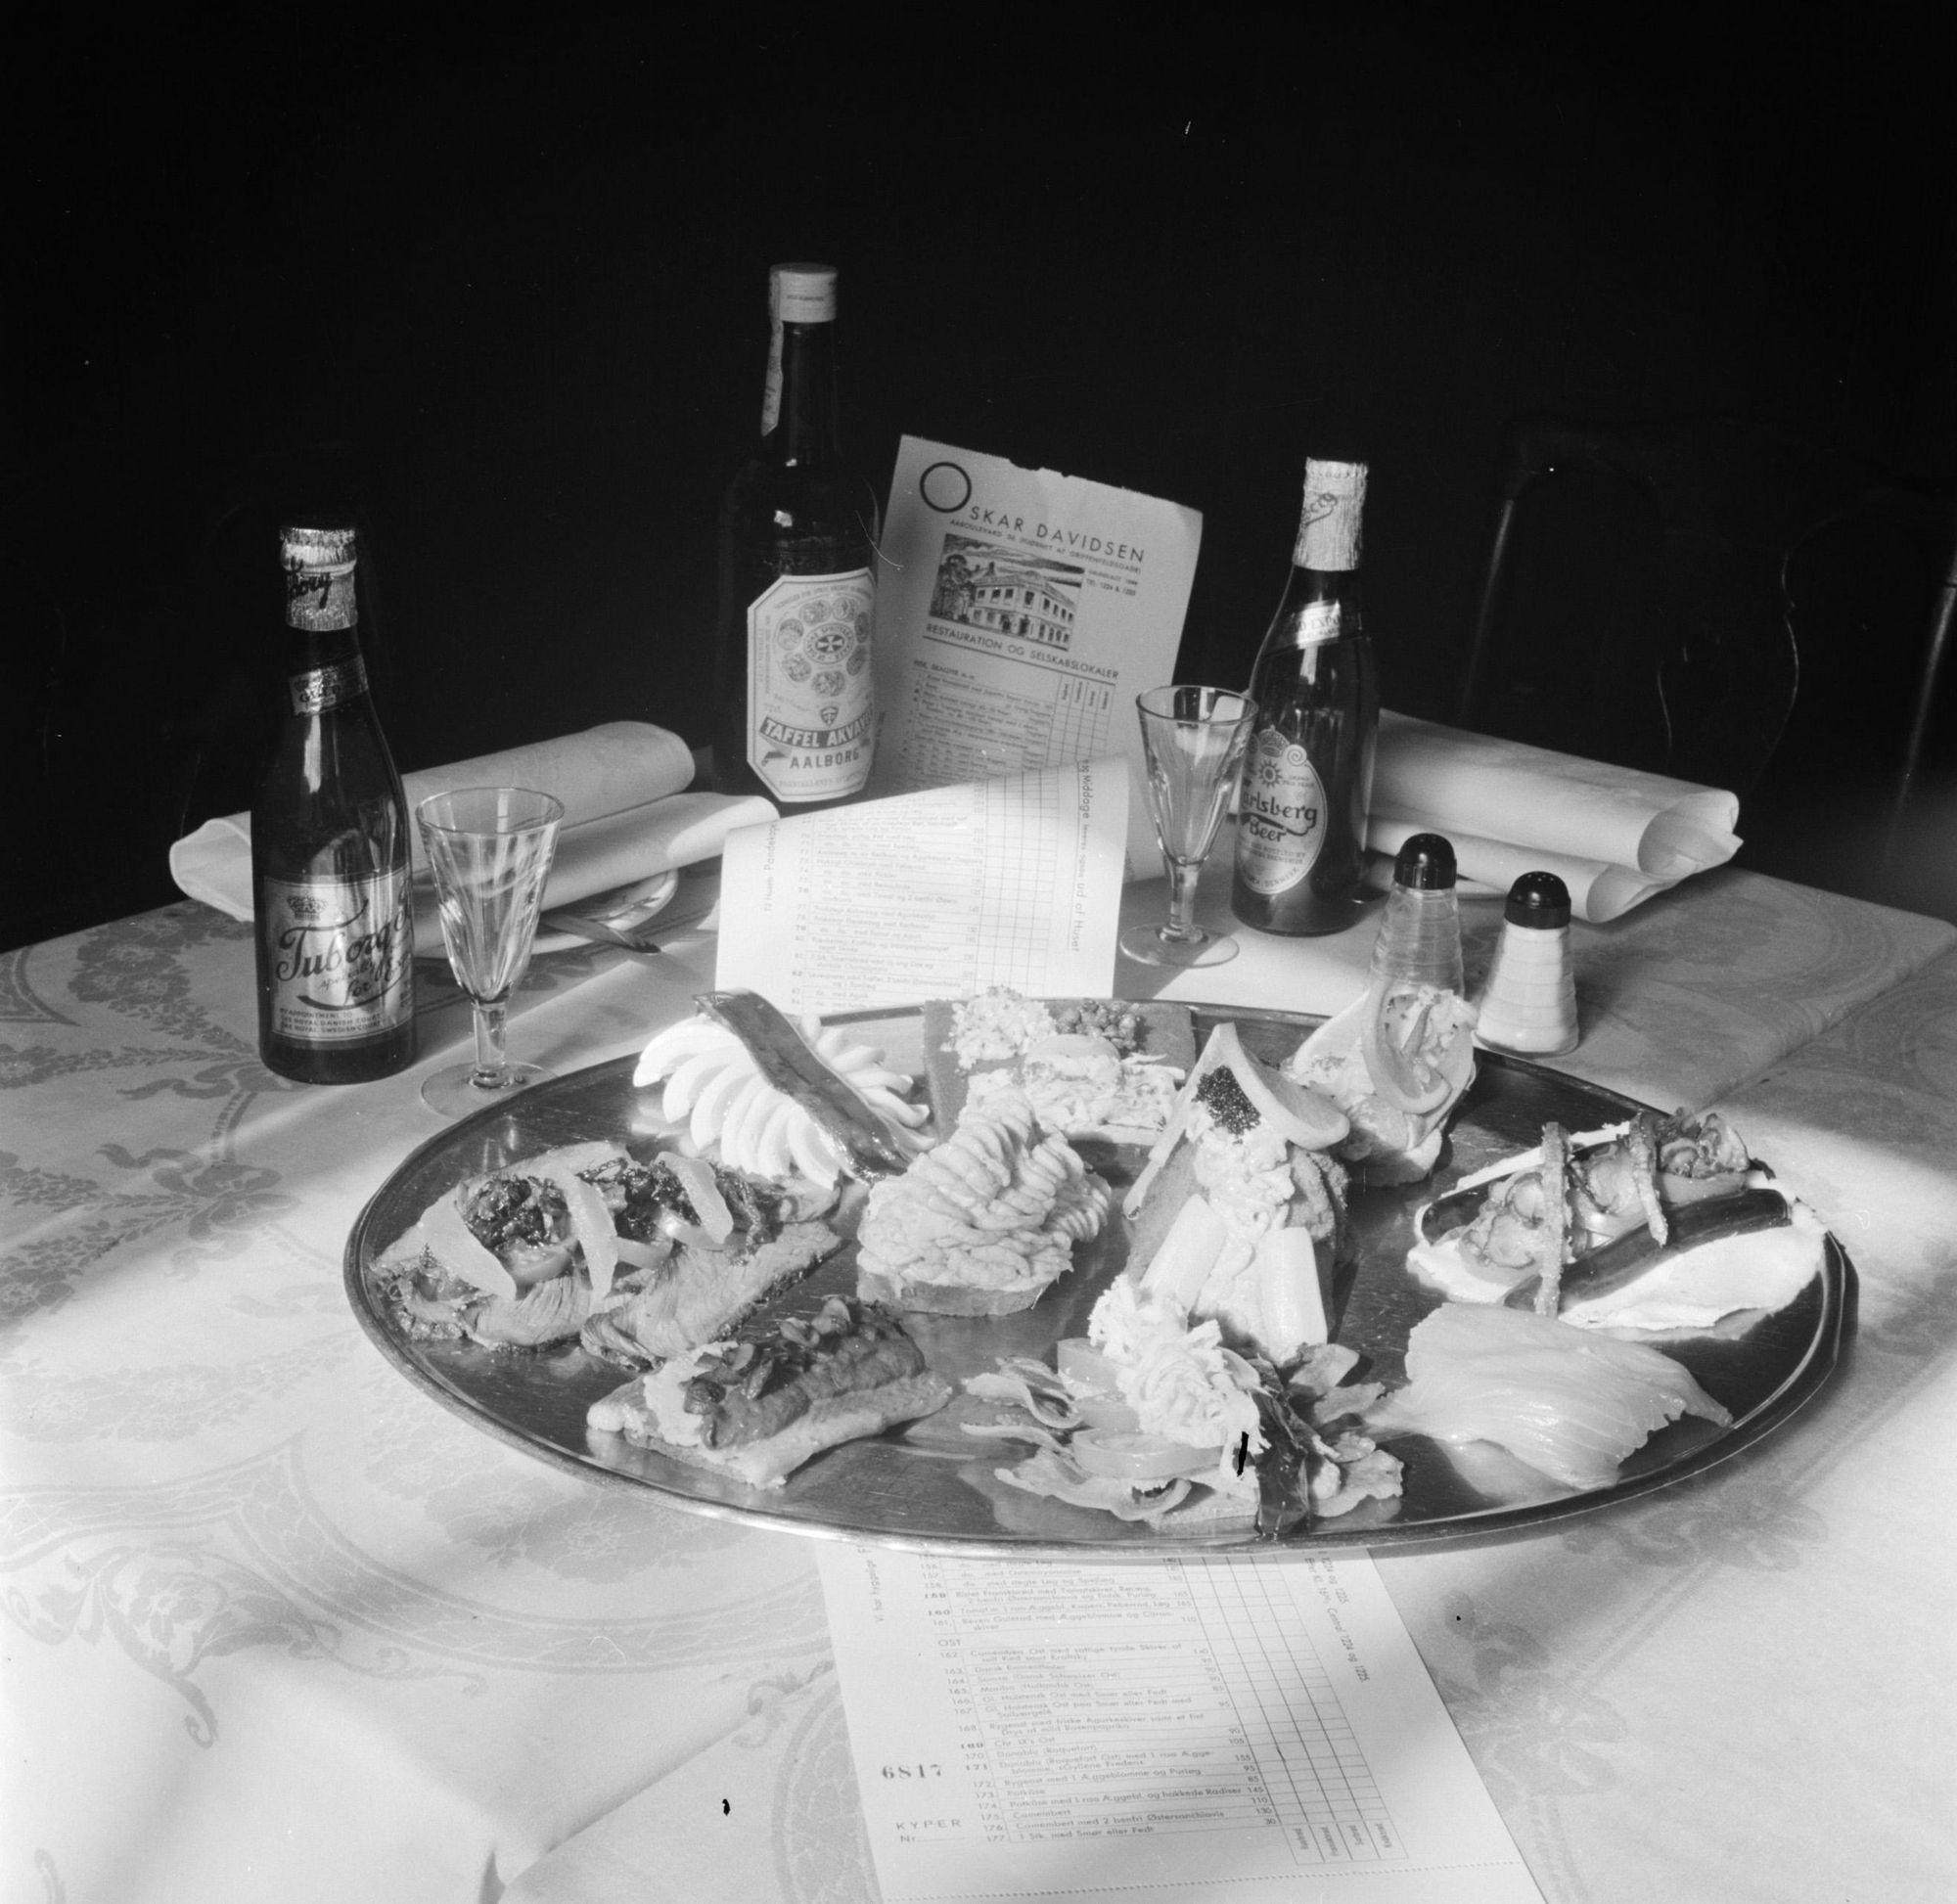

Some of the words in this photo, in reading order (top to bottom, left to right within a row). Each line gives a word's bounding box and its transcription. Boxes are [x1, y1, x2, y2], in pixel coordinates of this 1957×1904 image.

[1036, 523, 1146, 564] DAVIDSEN
[927, 622, 1003, 651] RESTAURATION
[1008, 643, 1025, 657] OG
[1030, 649, 1119, 680] SELSKABSLOKALER
[765, 719, 821, 748] TAFFEL
[790, 748, 860, 769] AALBORG
[1079, 775, 1093, 819] Middage
[1242, 791, 1318, 830] arlsberg
[1249, 818, 1287, 843] Beer
[1077, 883, 1086, 896] ud
[296, 1017, 318, 1025] ROYAL
[320, 1018, 354, 1026] DANISH
[356, 1014, 382, 1024] COURT
[322, 1023, 356, 1033] SWEDISH
[357, 1020, 382, 1031] COURT
[1340, 1635, 1354, 1651] 1224
[1347, 1653, 1358, 1662] og
[1353, 1665, 1370, 1683] 1225
[1122, 1689, 1143, 1698] eller
[1147, 1688, 1167, 1697] Fedt
[1122, 1699, 1144, 1707] eller
[1147, 1698, 1168, 1706] Fedt
[1038, 1736, 1056, 1745] Ost
[1125, 1751, 1147, 1760] med
[882, 1763, 943, 1780] 6817
[1004, 1777, 1044, 1788] Rygeost
[1047, 1774, 1070, 1783] med
[1080, 1770, 1150, 1783] Æggeblomme
[1152, 1769, 1167, 1778] og
[1168, 1766, 1203, 1777] Purløg
[1243, 1764, 1256, 1773] 95
[1051, 1795, 1072, 1805] med
[1146, 1791, 1161, 1801] og
[1161, 1789, 1205, 1798] hakkede
[1205, 1786, 1243, 1795] Radiser
[1247, 1786, 1265, 1794] 145
[1012, 1809, 1071, 1820] Camembert
[1251, 1796, 1269, 1805] 110
[895, 1818, 962, 1831] KYPER
[1015, 1819, 1074, 1831] Camembert
[1077, 1817, 1100, 1827] med
[1113, 1814, 1144, 1825] benfri
[1146, 1810, 1226, 1824] Østersanchiovis
[1050, 1829, 1073, 1838] med
[1074, 1827, 1104, 1837] Smør
[1105, 1825, 1128, 1835] eller
[1131, 1823, 1156, 1833] Fedt
